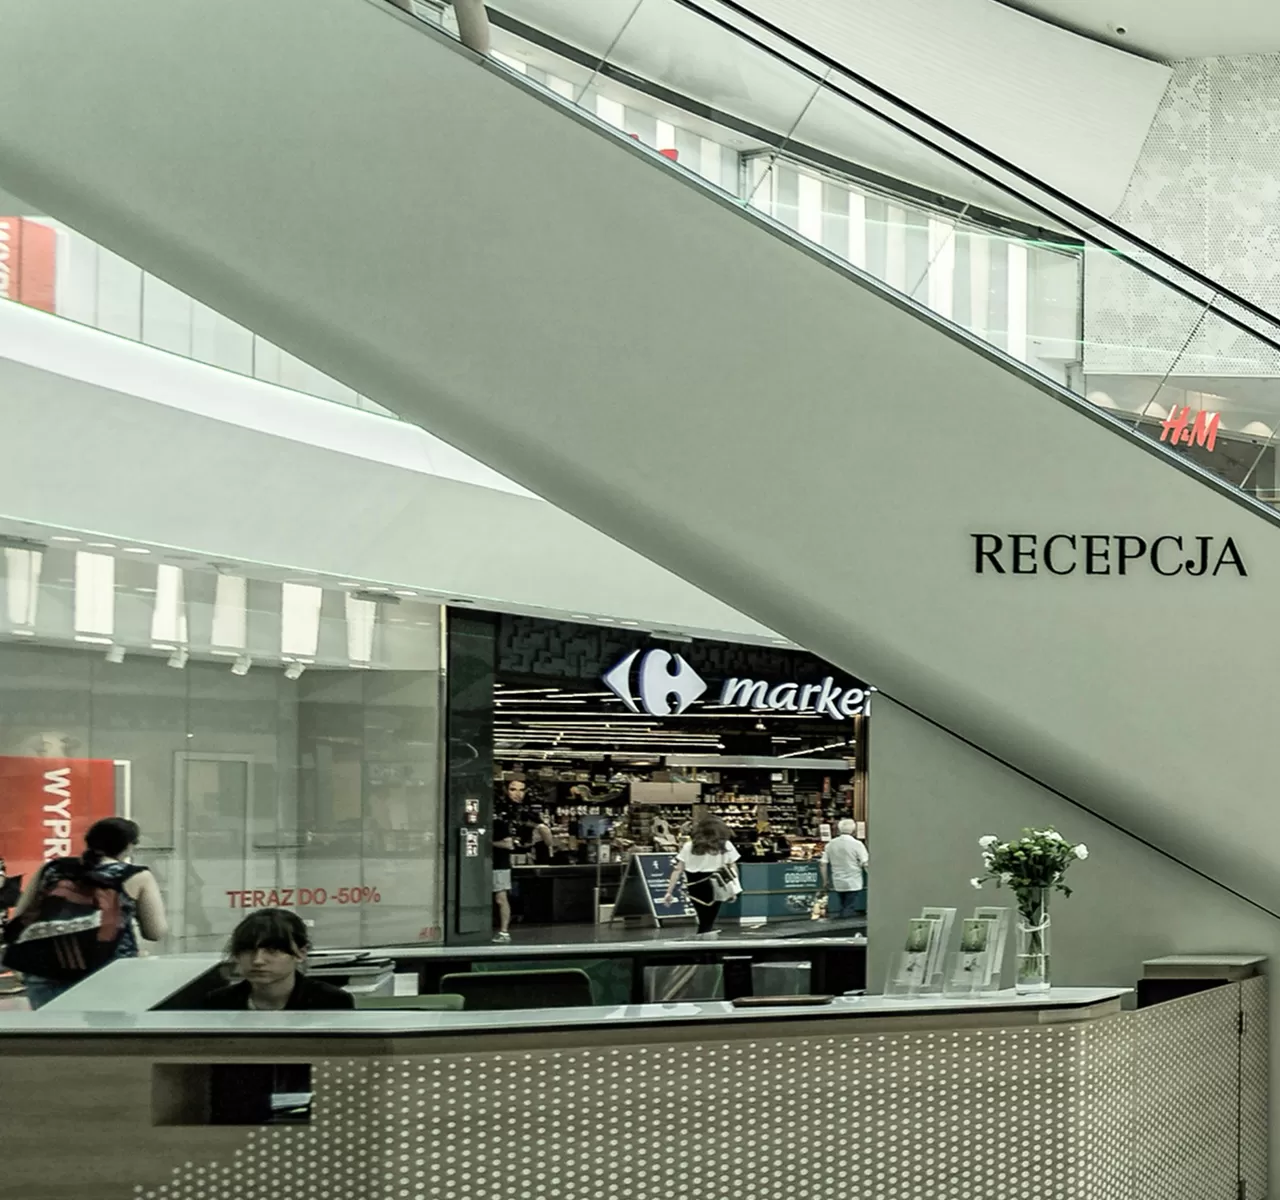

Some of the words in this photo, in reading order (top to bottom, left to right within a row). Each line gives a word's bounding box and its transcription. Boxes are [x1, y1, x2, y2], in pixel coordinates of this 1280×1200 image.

[1159, 404, 1221, 452] H&M
[969, 533, 1249, 577] RECEPCJA
[226, 888, 294, 908] TERAZ
[297, 887, 327, 906] DO
[330, 885, 381, 904] -50%
